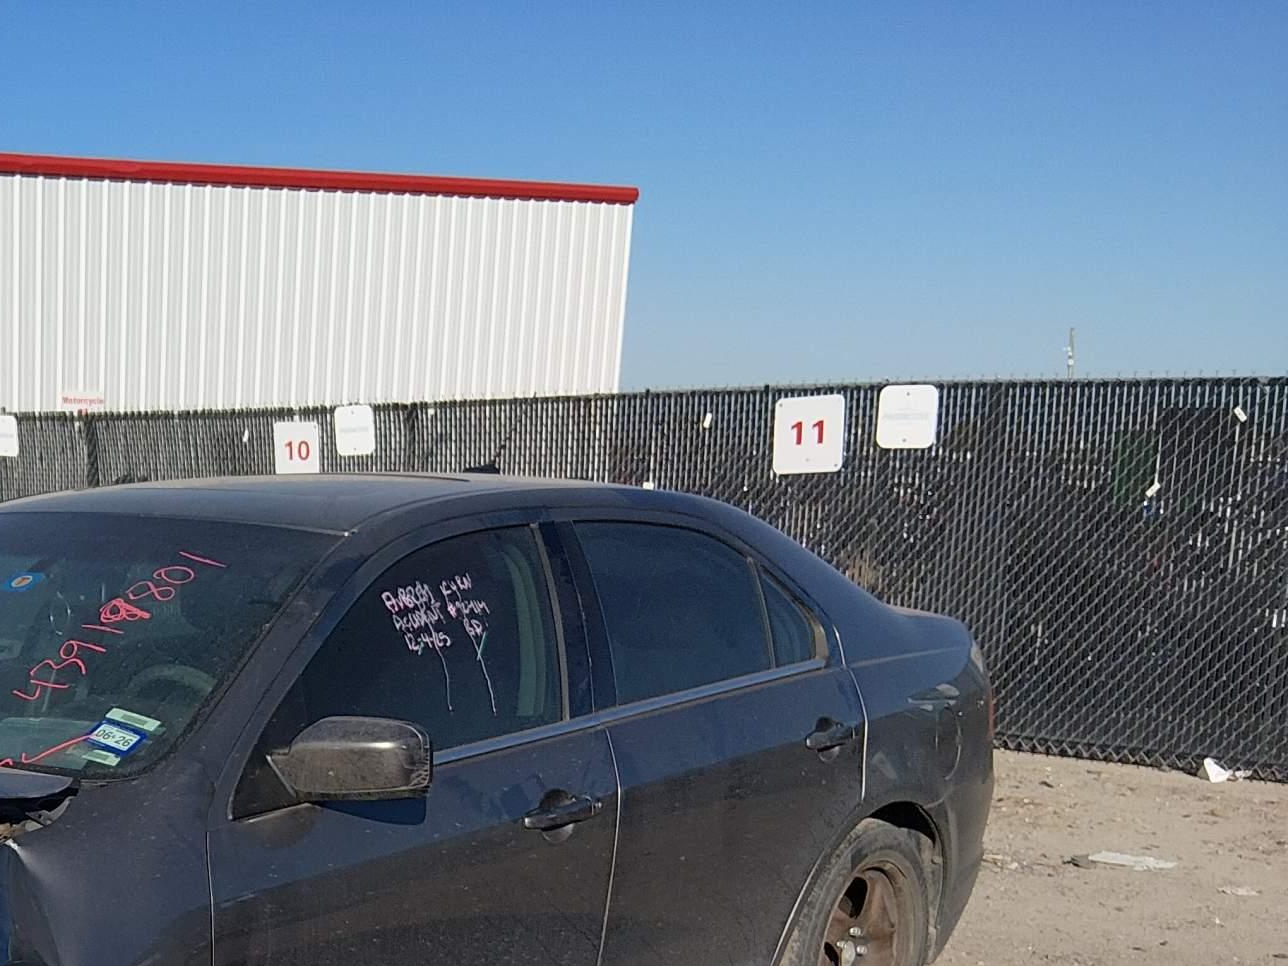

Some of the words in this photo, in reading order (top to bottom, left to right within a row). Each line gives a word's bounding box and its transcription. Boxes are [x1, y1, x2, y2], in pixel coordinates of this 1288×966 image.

[791, 420, 824, 445] 11
[284, 440, 310, 460] 10
[95, 729, 111, 741] 06
[114, 735, 133, 747] 26
